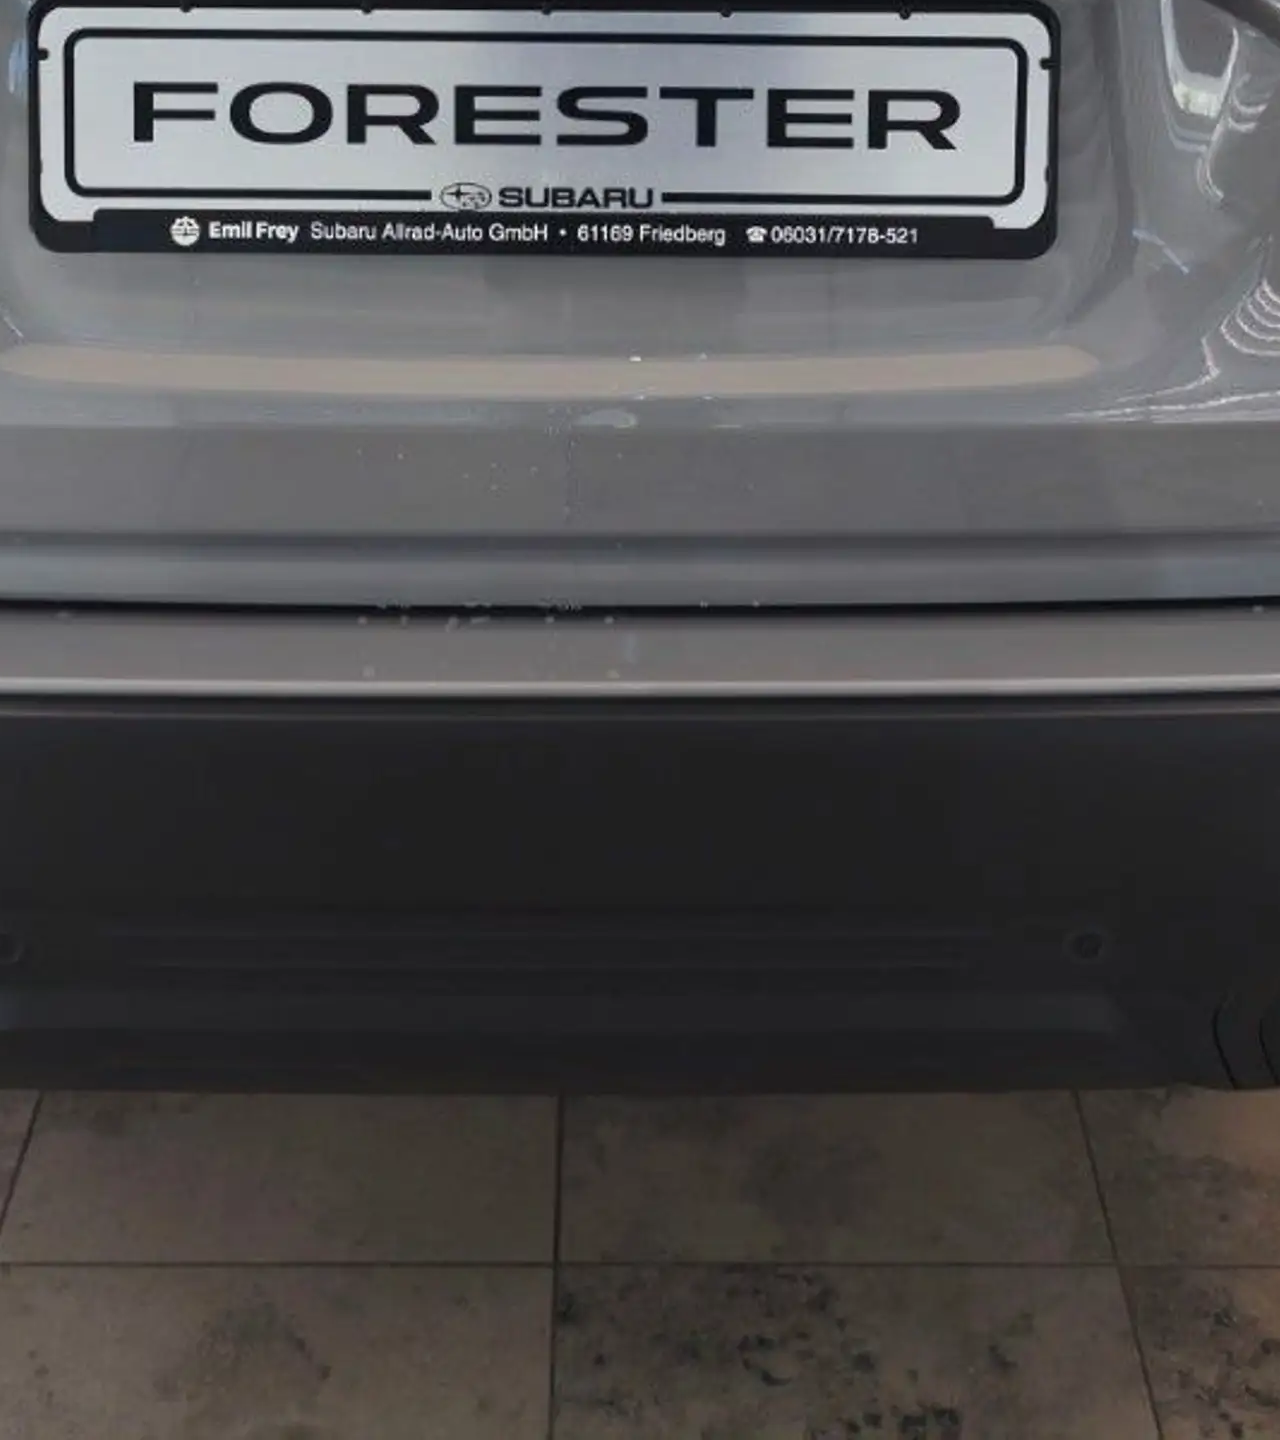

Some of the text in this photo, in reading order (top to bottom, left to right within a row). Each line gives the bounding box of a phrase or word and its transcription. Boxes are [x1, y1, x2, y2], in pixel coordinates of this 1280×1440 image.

[131, 79, 961, 150] FORESTER
[498, 187, 654, 209] SUBARU
[208, 221, 919, 247] Emil Frey Subaru Allrad-Auto GmbH 61169 Friedberg 06031/7178-521
